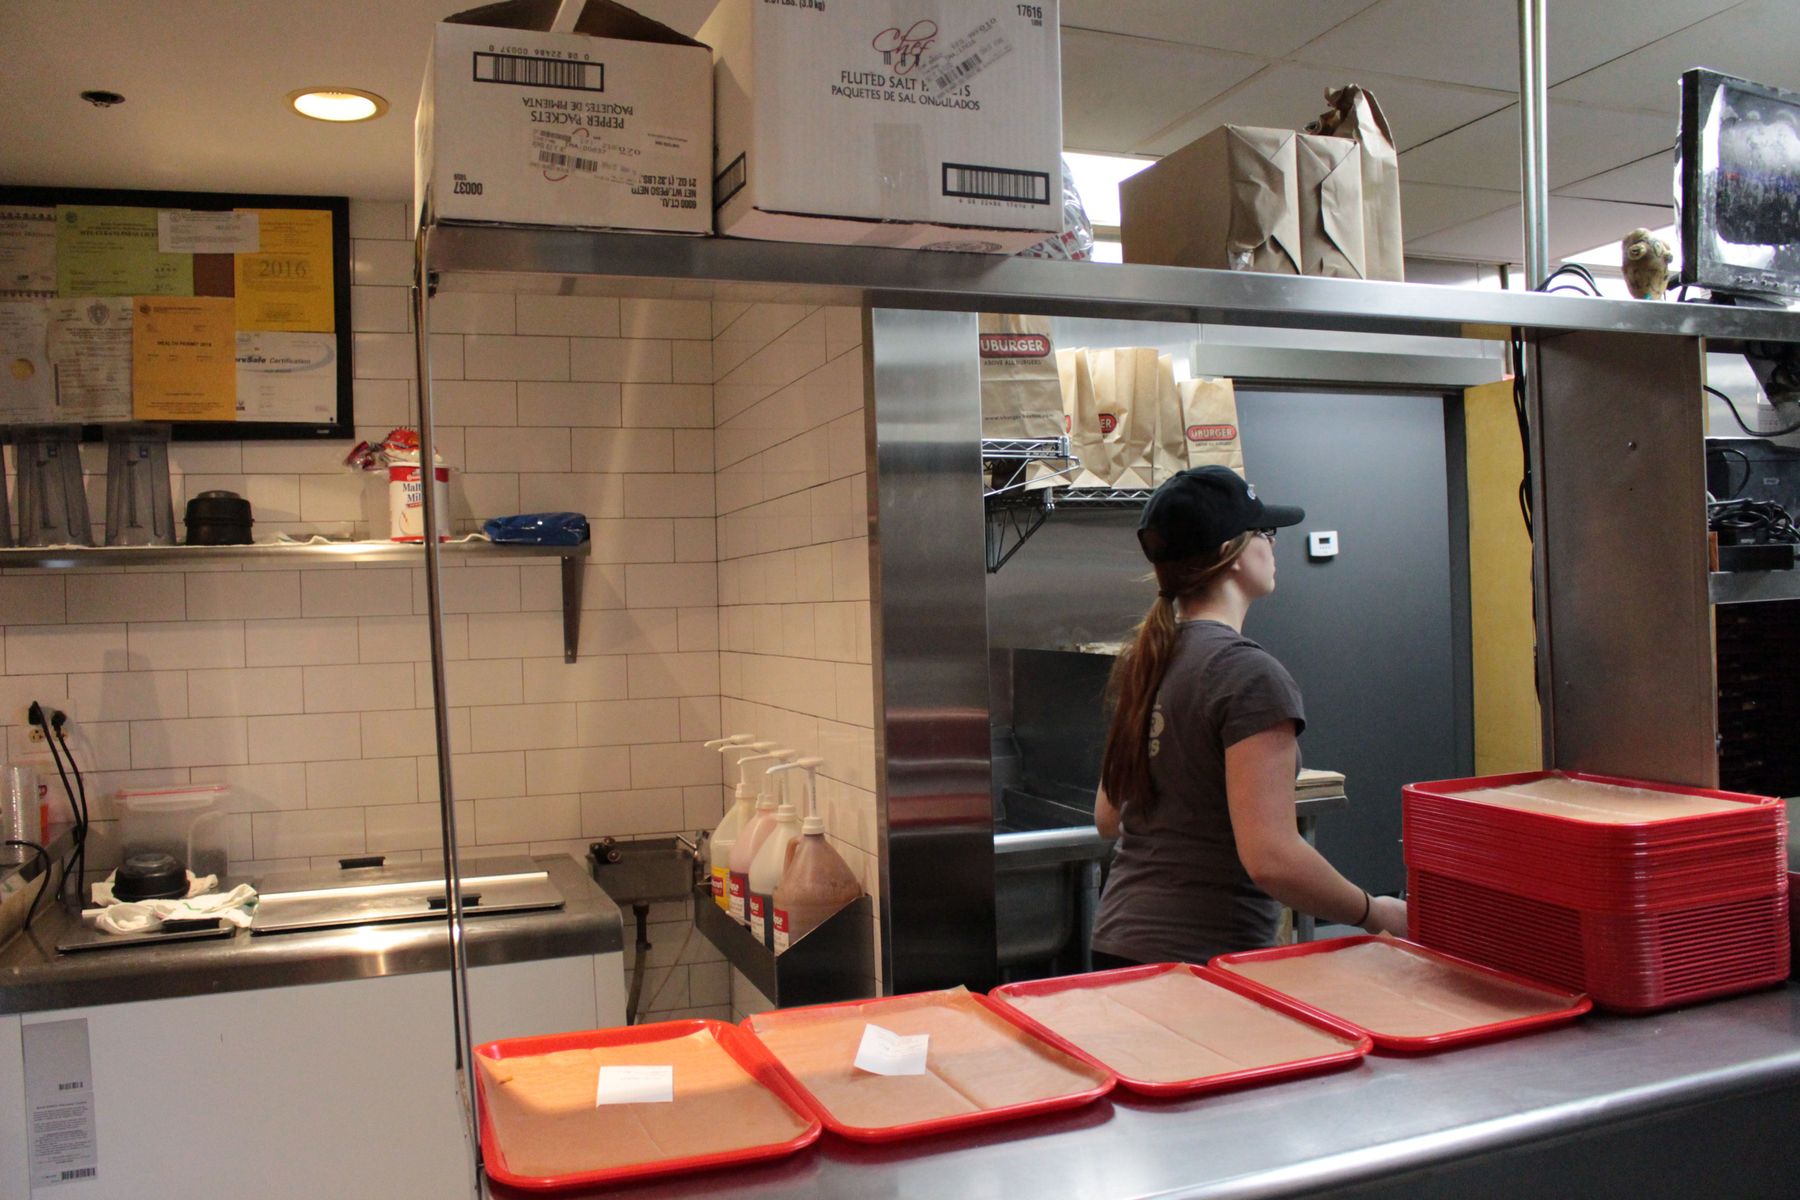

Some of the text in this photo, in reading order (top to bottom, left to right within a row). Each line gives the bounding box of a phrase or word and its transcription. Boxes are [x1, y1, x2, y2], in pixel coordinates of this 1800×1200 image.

[1016, 3, 1042, 19] 17616
[872, 19, 938, 75] Chef
[841, 71, 886, 87] FLUTED
[889, 76, 917, 91] SALT
[831, 85, 881, 100] PAQUETES
[884, 91, 895, 102] DE
[898, 92, 916, 104] SAL
[522, 97, 633, 116] PAQUETES DE PIMIENTA
[530, 110, 624, 129] PEPPER PACKETS
[453, 182, 483, 196] 00037
[688, 178, 697, 187] 21
[684, 187, 697, 198] NET
[258, 260, 307, 279] 2016
[980, 339, 1044, 352] UBURGER
[1191, 428, 1232, 438] UBURGER
[403, 482, 421, 492] Malt
[407, 493, 421, 502] Mil
